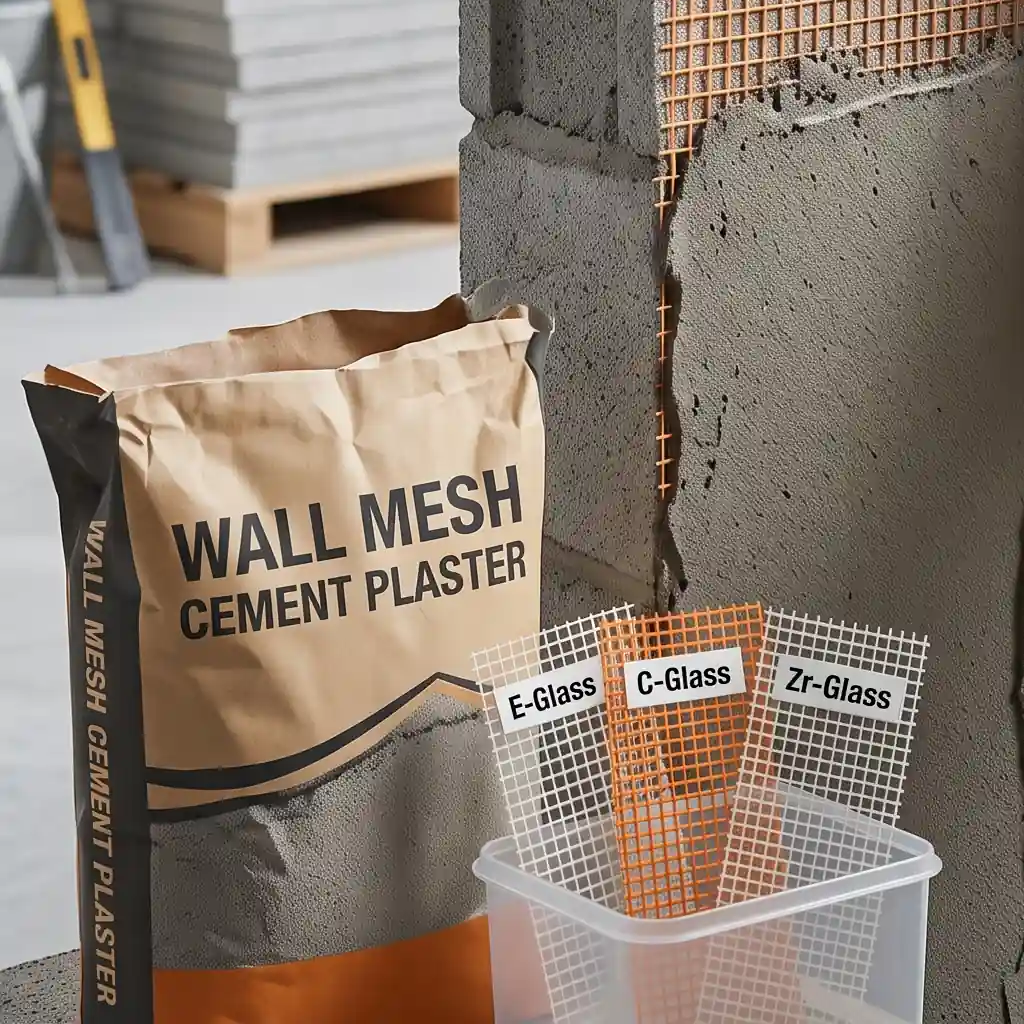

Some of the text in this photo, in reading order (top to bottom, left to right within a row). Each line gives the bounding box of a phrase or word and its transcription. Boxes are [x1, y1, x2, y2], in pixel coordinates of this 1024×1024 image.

[172, 465, 523, 582] WALL MESH
[180, 540, 526, 640] CEMENT PLASTER
[508, 677, 597, 720] E-Glass
[637, 665, 731, 695] C-Glass
[785, 667, 891, 709] Zr-Glass
[83, 519, 118, 1007] WALL MESH CEMENT PLASTER
